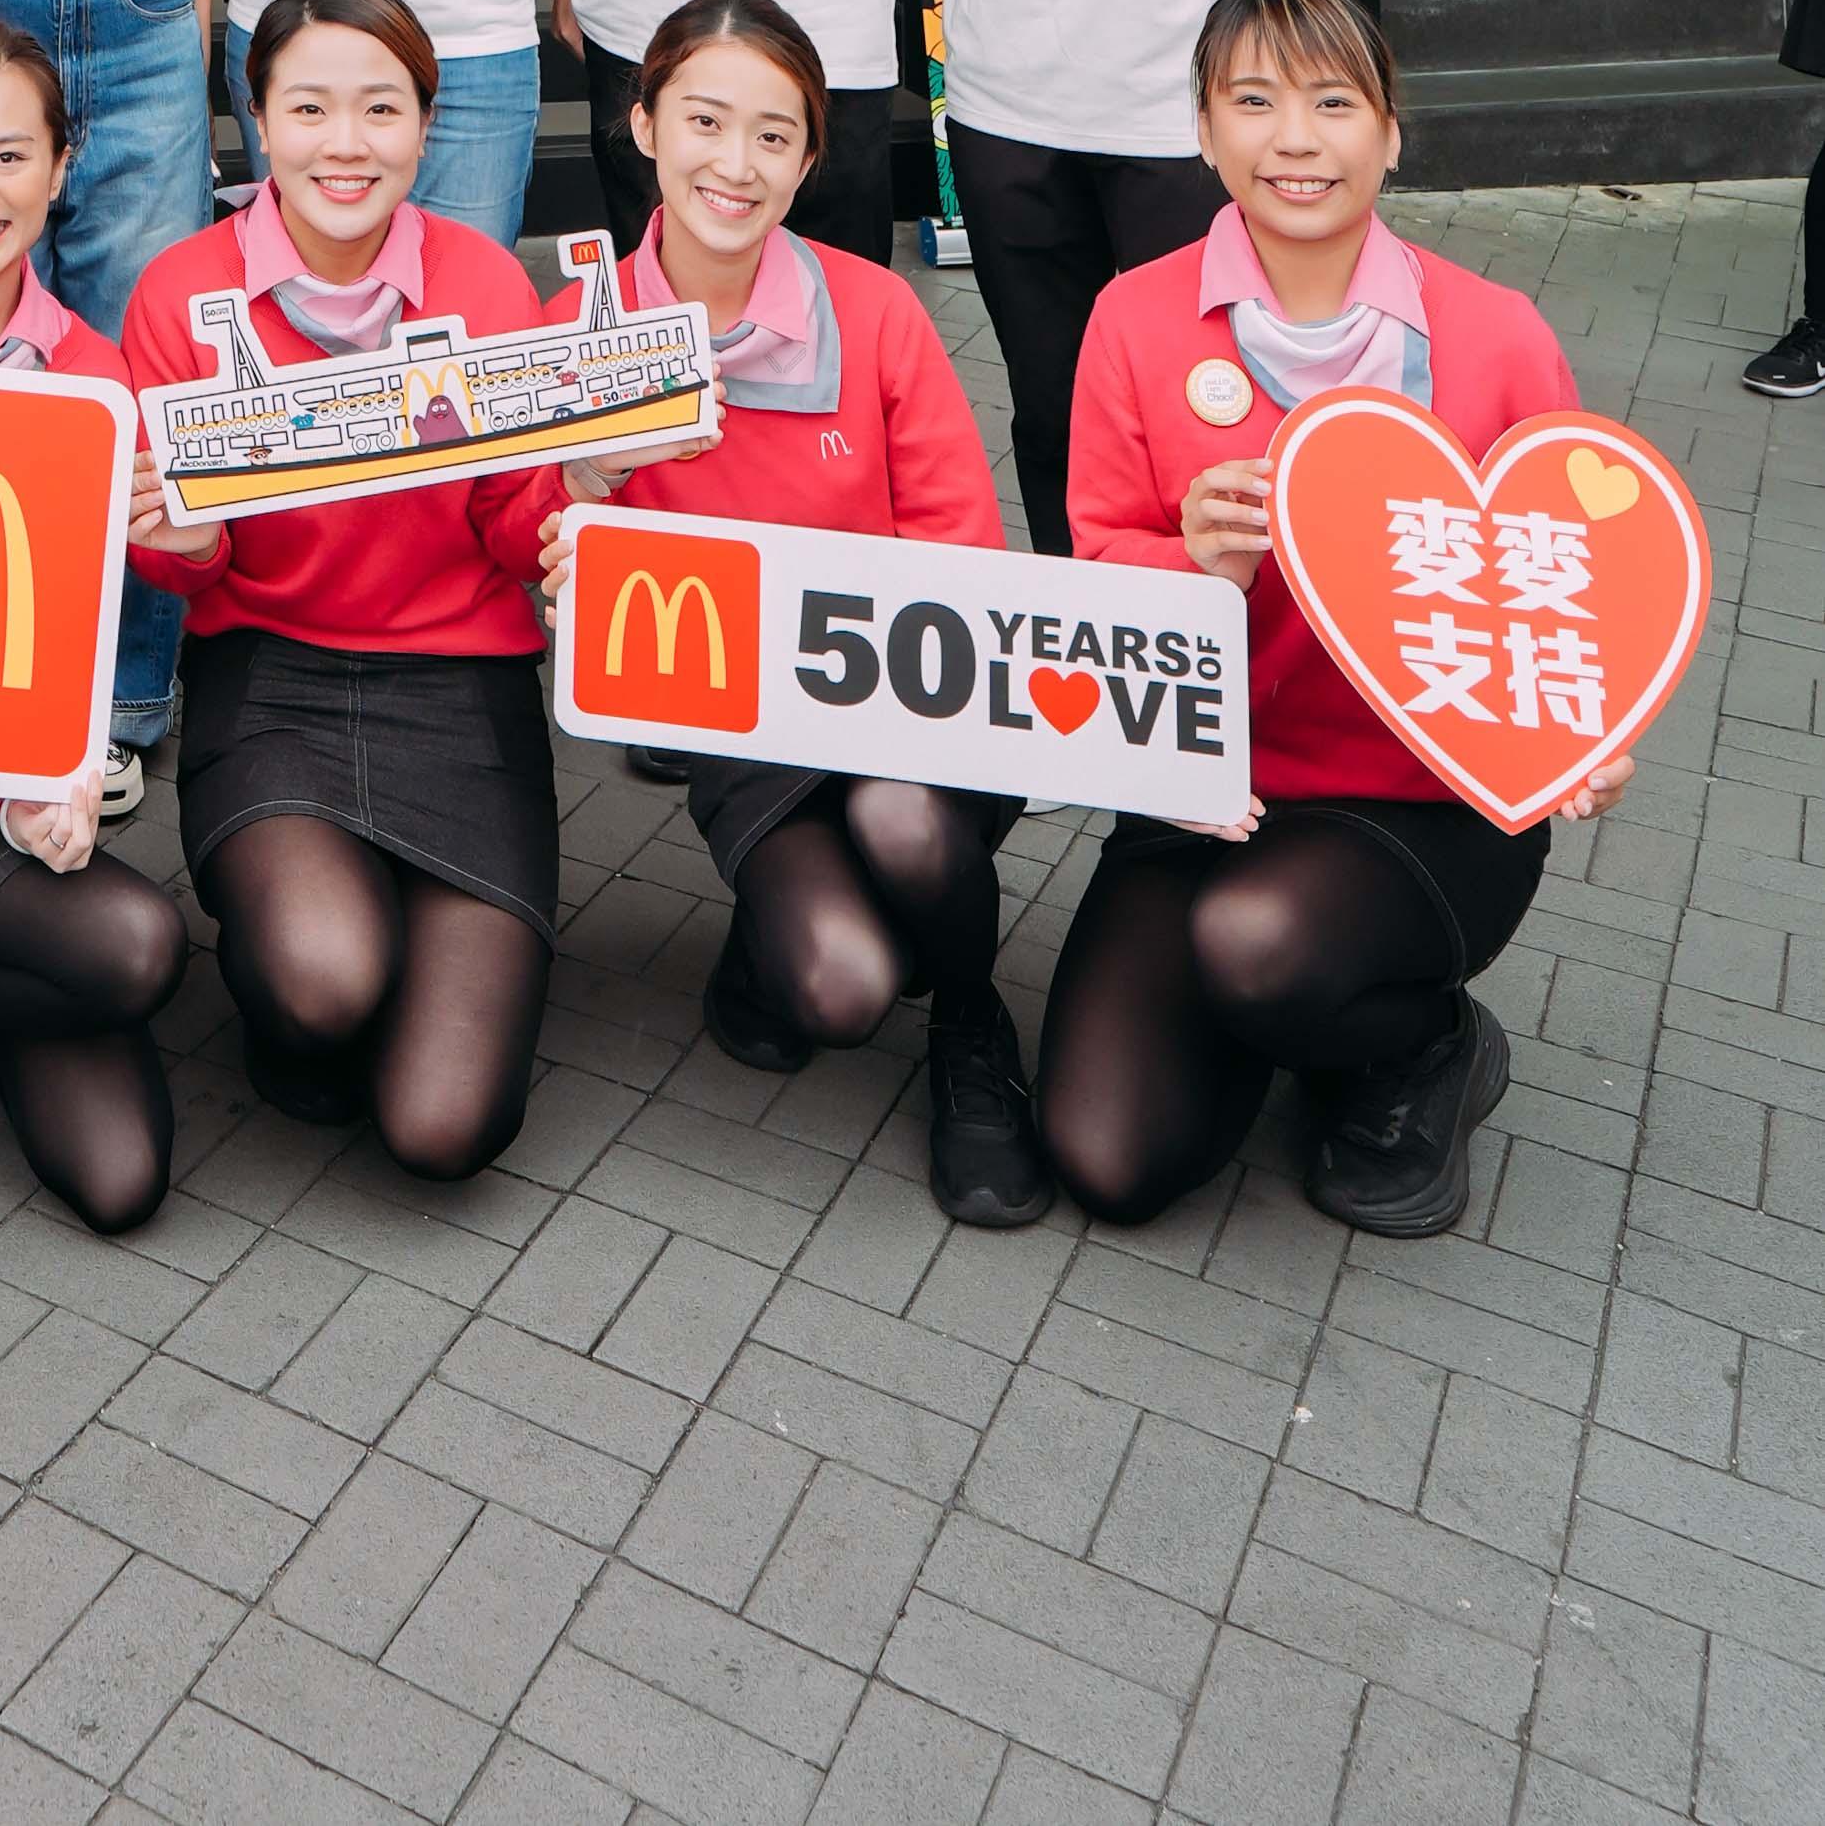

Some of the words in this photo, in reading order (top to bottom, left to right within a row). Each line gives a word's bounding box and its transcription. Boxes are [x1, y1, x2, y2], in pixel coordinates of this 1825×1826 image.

[603, 391, 619, 405] 50
[179, 459, 229, 468] McDonald's
[794, 588, 977, 720] 50
[986, 608, 1192, 678] YEARS
[1393, 611, 1607, 738] 支持
